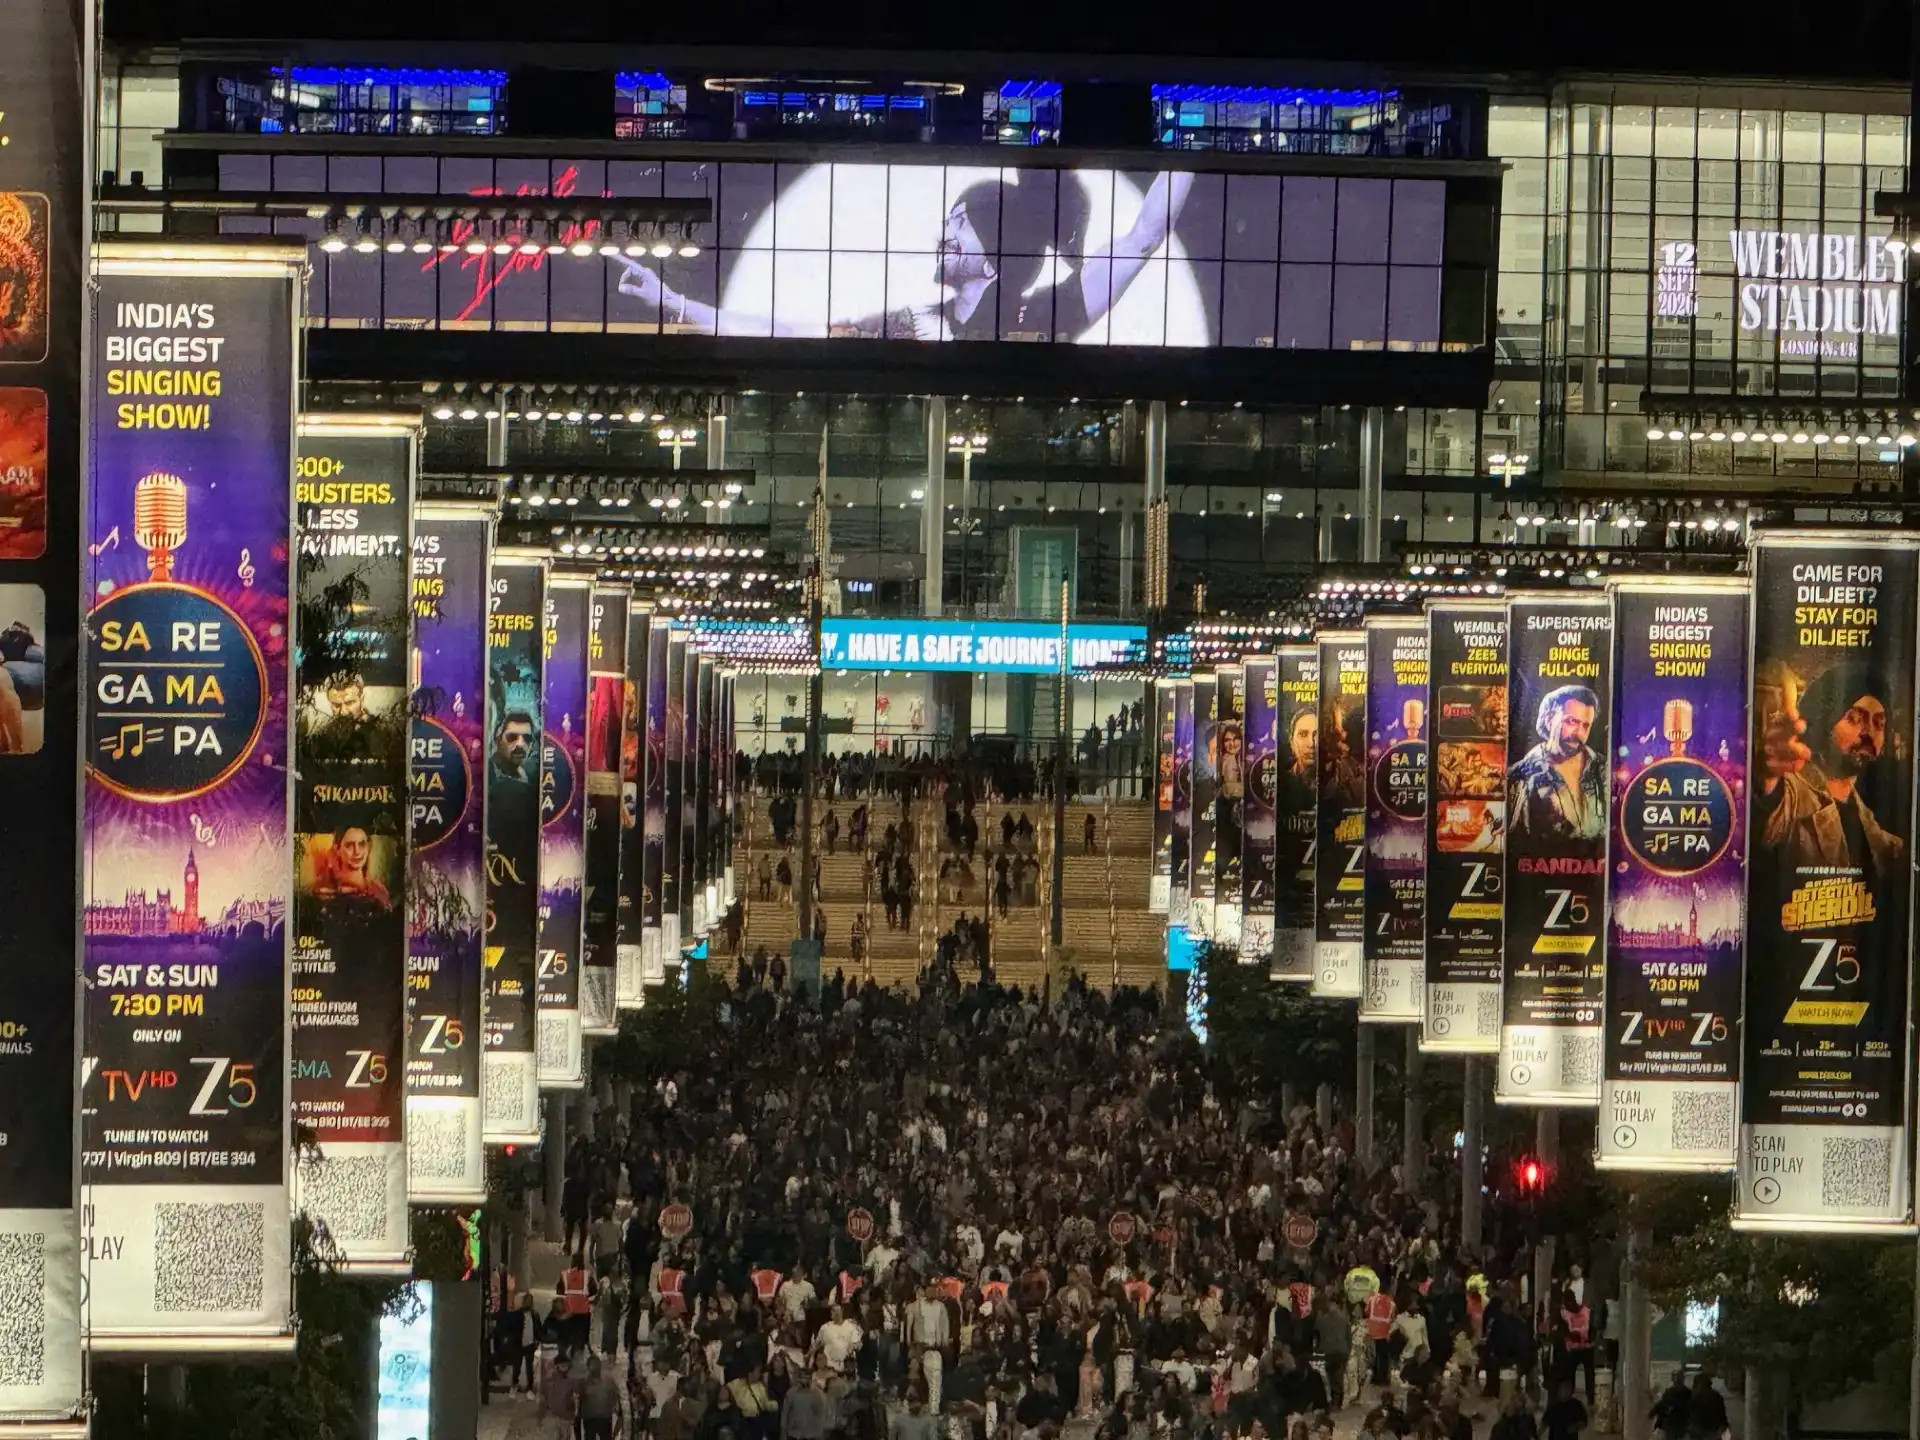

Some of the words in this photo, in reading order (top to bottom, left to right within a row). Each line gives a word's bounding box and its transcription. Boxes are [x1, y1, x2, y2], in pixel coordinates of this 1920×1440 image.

[1660, 242, 1697, 266] 12
[1730, 230, 1907, 283] WEMBLEY
[117, 303, 214, 329] INDIA'S
[1740, 284, 1898, 335] STADIUM
[106, 336, 224, 363] BIGGEST
[107, 369, 221, 396] SINGING
[117, 403, 211, 430] SHOW!
[1792, 564, 1843, 582] CAME
[1847, 564, 1883, 583] FOR
[1797, 585, 1878, 605] DILJEET?
[1655, 606, 1708, 623] INDIA'S
[1794, 607, 1839, 625] STAY
[1842, 608, 1878, 625] FOR
[100, 621, 152, 652] SA
[172, 622, 221, 652] RE
[1648, 624, 1714, 640] BIGGEST
[1799, 628, 1873, 647] DILJEET.
[849, 633, 901, 661] HAVE
[904, 634, 919, 662] A
[922, 634, 973, 664] SAFE
[1549, 646, 1590, 661] BINGE
[1649, 642, 1712, 659] SINGING
[1538, 662, 1600, 678] FULL-ON!
[1655, 661, 1706, 678] SHOW!
[97, 674, 153, 705] GA
[166, 675, 224, 705] MA
[173, 725, 223, 756] PA
[1644, 777, 1673, 796] SA
[1683, 778, 1711, 796] RE
[1642, 805, 1674, 824] GA
[1680, 807, 1712, 825] MA
[1683, 834, 1711, 853] PA
[97, 964, 142, 987] SAT
[145, 964, 166, 987] &
[168, 964, 218, 987] SUN
[1641, 963, 1667, 977] SAT
[1680, 963, 1707, 977] SUN
[1649, 978, 1677, 992] 7:30
[1679, 979, 1700, 992] PM
[110, 994, 161, 1016] 7:30
[167, 994, 204, 1017] PM
[133, 1029, 163, 1043] ONLY
[163, 1029, 182, 1043] ON
[1613, 1089, 1641, 1105] SCAN
[1629, 1107, 1656, 1123] PLAY
[104, 1129, 136, 1144] TUNE
[151, 1130, 166, 1144] TO
[167, 1130, 209, 1144] WATCH
[1752, 1135, 1786, 1153] SCAN
[1754, 1156, 1769, 1173] TO
[1772, 1156, 1804, 1174] PLAY
